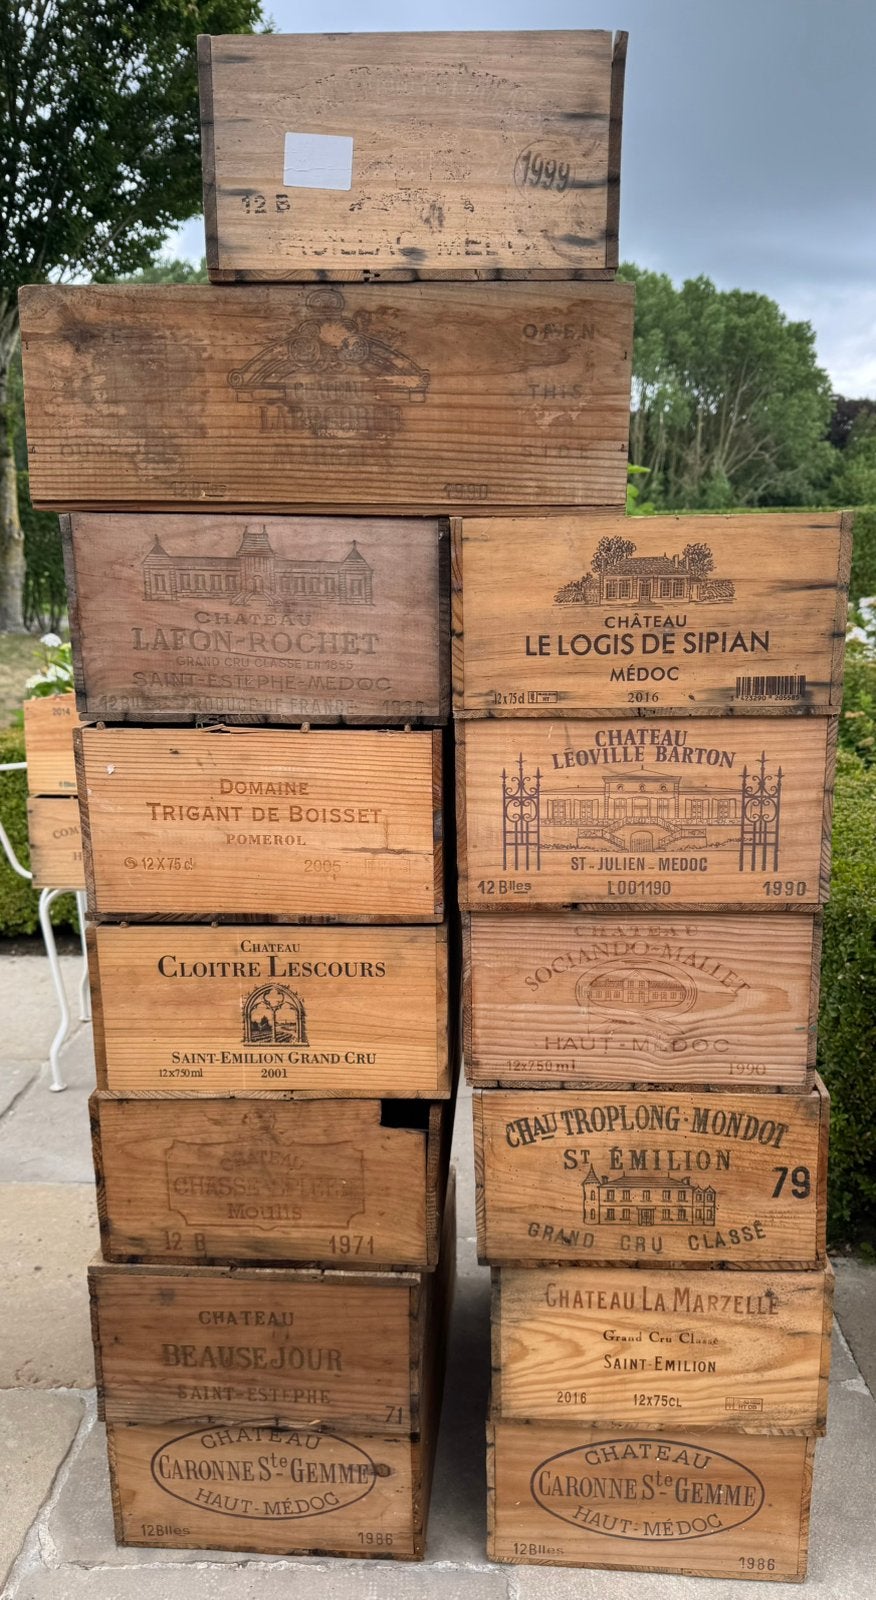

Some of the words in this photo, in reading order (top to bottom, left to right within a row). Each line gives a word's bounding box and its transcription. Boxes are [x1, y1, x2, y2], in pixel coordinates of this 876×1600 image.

[520, 150, 571, 193] 1999
[241, 195, 267, 213] 12
[528, 383, 584, 400] THIS
[194, 611, 313, 626] CHATEAU
[604, 613, 687, 629] CHÂTEAU
[132, 627, 380, 655] LAFON-ROCHET
[526, 634, 551, 656] LE
[558, 633, 634, 656] LOGIS
[642, 633, 676, 655] DE
[683, 630, 770, 654] SIPIAN
[176, 656, 220, 668] GRAND
[224, 657, 250, 669] CRU
[325, 659, 354, 670] 1855
[609, 664, 679, 682] MÉDOC
[290, 699, 356, 714] FRANCE
[627, 691, 659, 704] 2016
[52, 707, 71, 716] 2014
[595, 728, 688, 748] CHATEAU
[655, 746, 736, 769] BARTON
[220, 778, 310, 795] DOMAINE
[146, 802, 243, 823] TRIGANT
[252, 806, 279, 822] DE
[289, 805, 383, 824] BOISSET
[226, 834, 307, 846] POMEROL
[304, 860, 342, 873] 2005
[762, 881, 807, 896] 1990
[240, 939, 301, 953] CHATEAU
[157, 955, 261, 978] CLOITRE
[267, 955, 386, 978] LESCOURS
[172, 1051, 284, 1065] SAINT-EMILION
[288, 1051, 340, 1065] GRAND
[344, 1052, 377, 1065] CRU
[261, 1068, 288, 1079] 2001
[728, 1062, 767, 1075] 1990
[610, 1145, 732, 1171] ÉMILION
[771, 1166, 811, 1199] 79
[165, 1232, 183, 1251] 12
[195, 1232, 206, 1251] B
[328, 1235, 374, 1255] 1971
[527, 1222, 595, 1249] GRAND
[620, 1235, 663, 1252] CRU
[688, 1220, 766, 1251] CLASSÉ
[545, 1283, 635, 1310] CHATEAU
[642, 1286, 665, 1310] LA
[673, 1287, 780, 1316] MARZELLE
[199, 1310, 295, 1326] CHATEAU
[603, 1329, 642, 1342] Grand
[649, 1331, 672, 1343] Cru
[161, 1343, 343, 1372] BEAUSEJOUR
[178, 1385, 331, 1405] SAINT-ESTEPHE
[557, 1391, 587, 1404] 2016
[385, 1405, 403, 1424] 71
[200, 1428, 323, 1450] CHATEAU
[584, 1443, 712, 1469] CHATEAU
[158, 1454, 254, 1481] CARONNE
[539, 1471, 637, 1500] CARONNE
[357, 1531, 394, 1545] 1986
[738, 1556, 776, 1571] 1986
